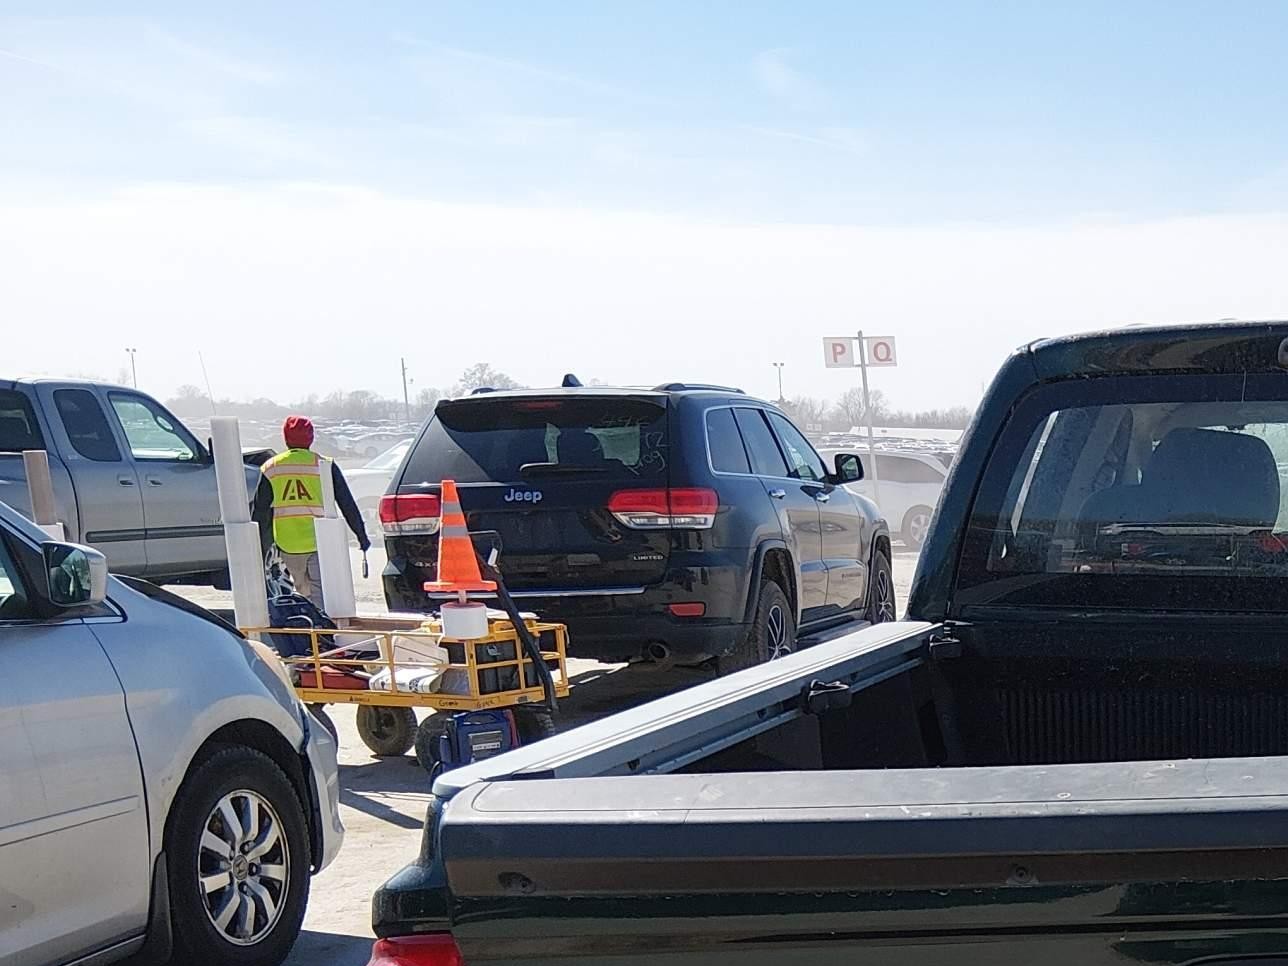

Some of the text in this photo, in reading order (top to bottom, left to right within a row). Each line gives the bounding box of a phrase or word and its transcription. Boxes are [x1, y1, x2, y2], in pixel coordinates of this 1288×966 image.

[832, 343, 846, 363] P
[873, 342, 893, 362] Q
[504, 488, 542, 504] Jeep
